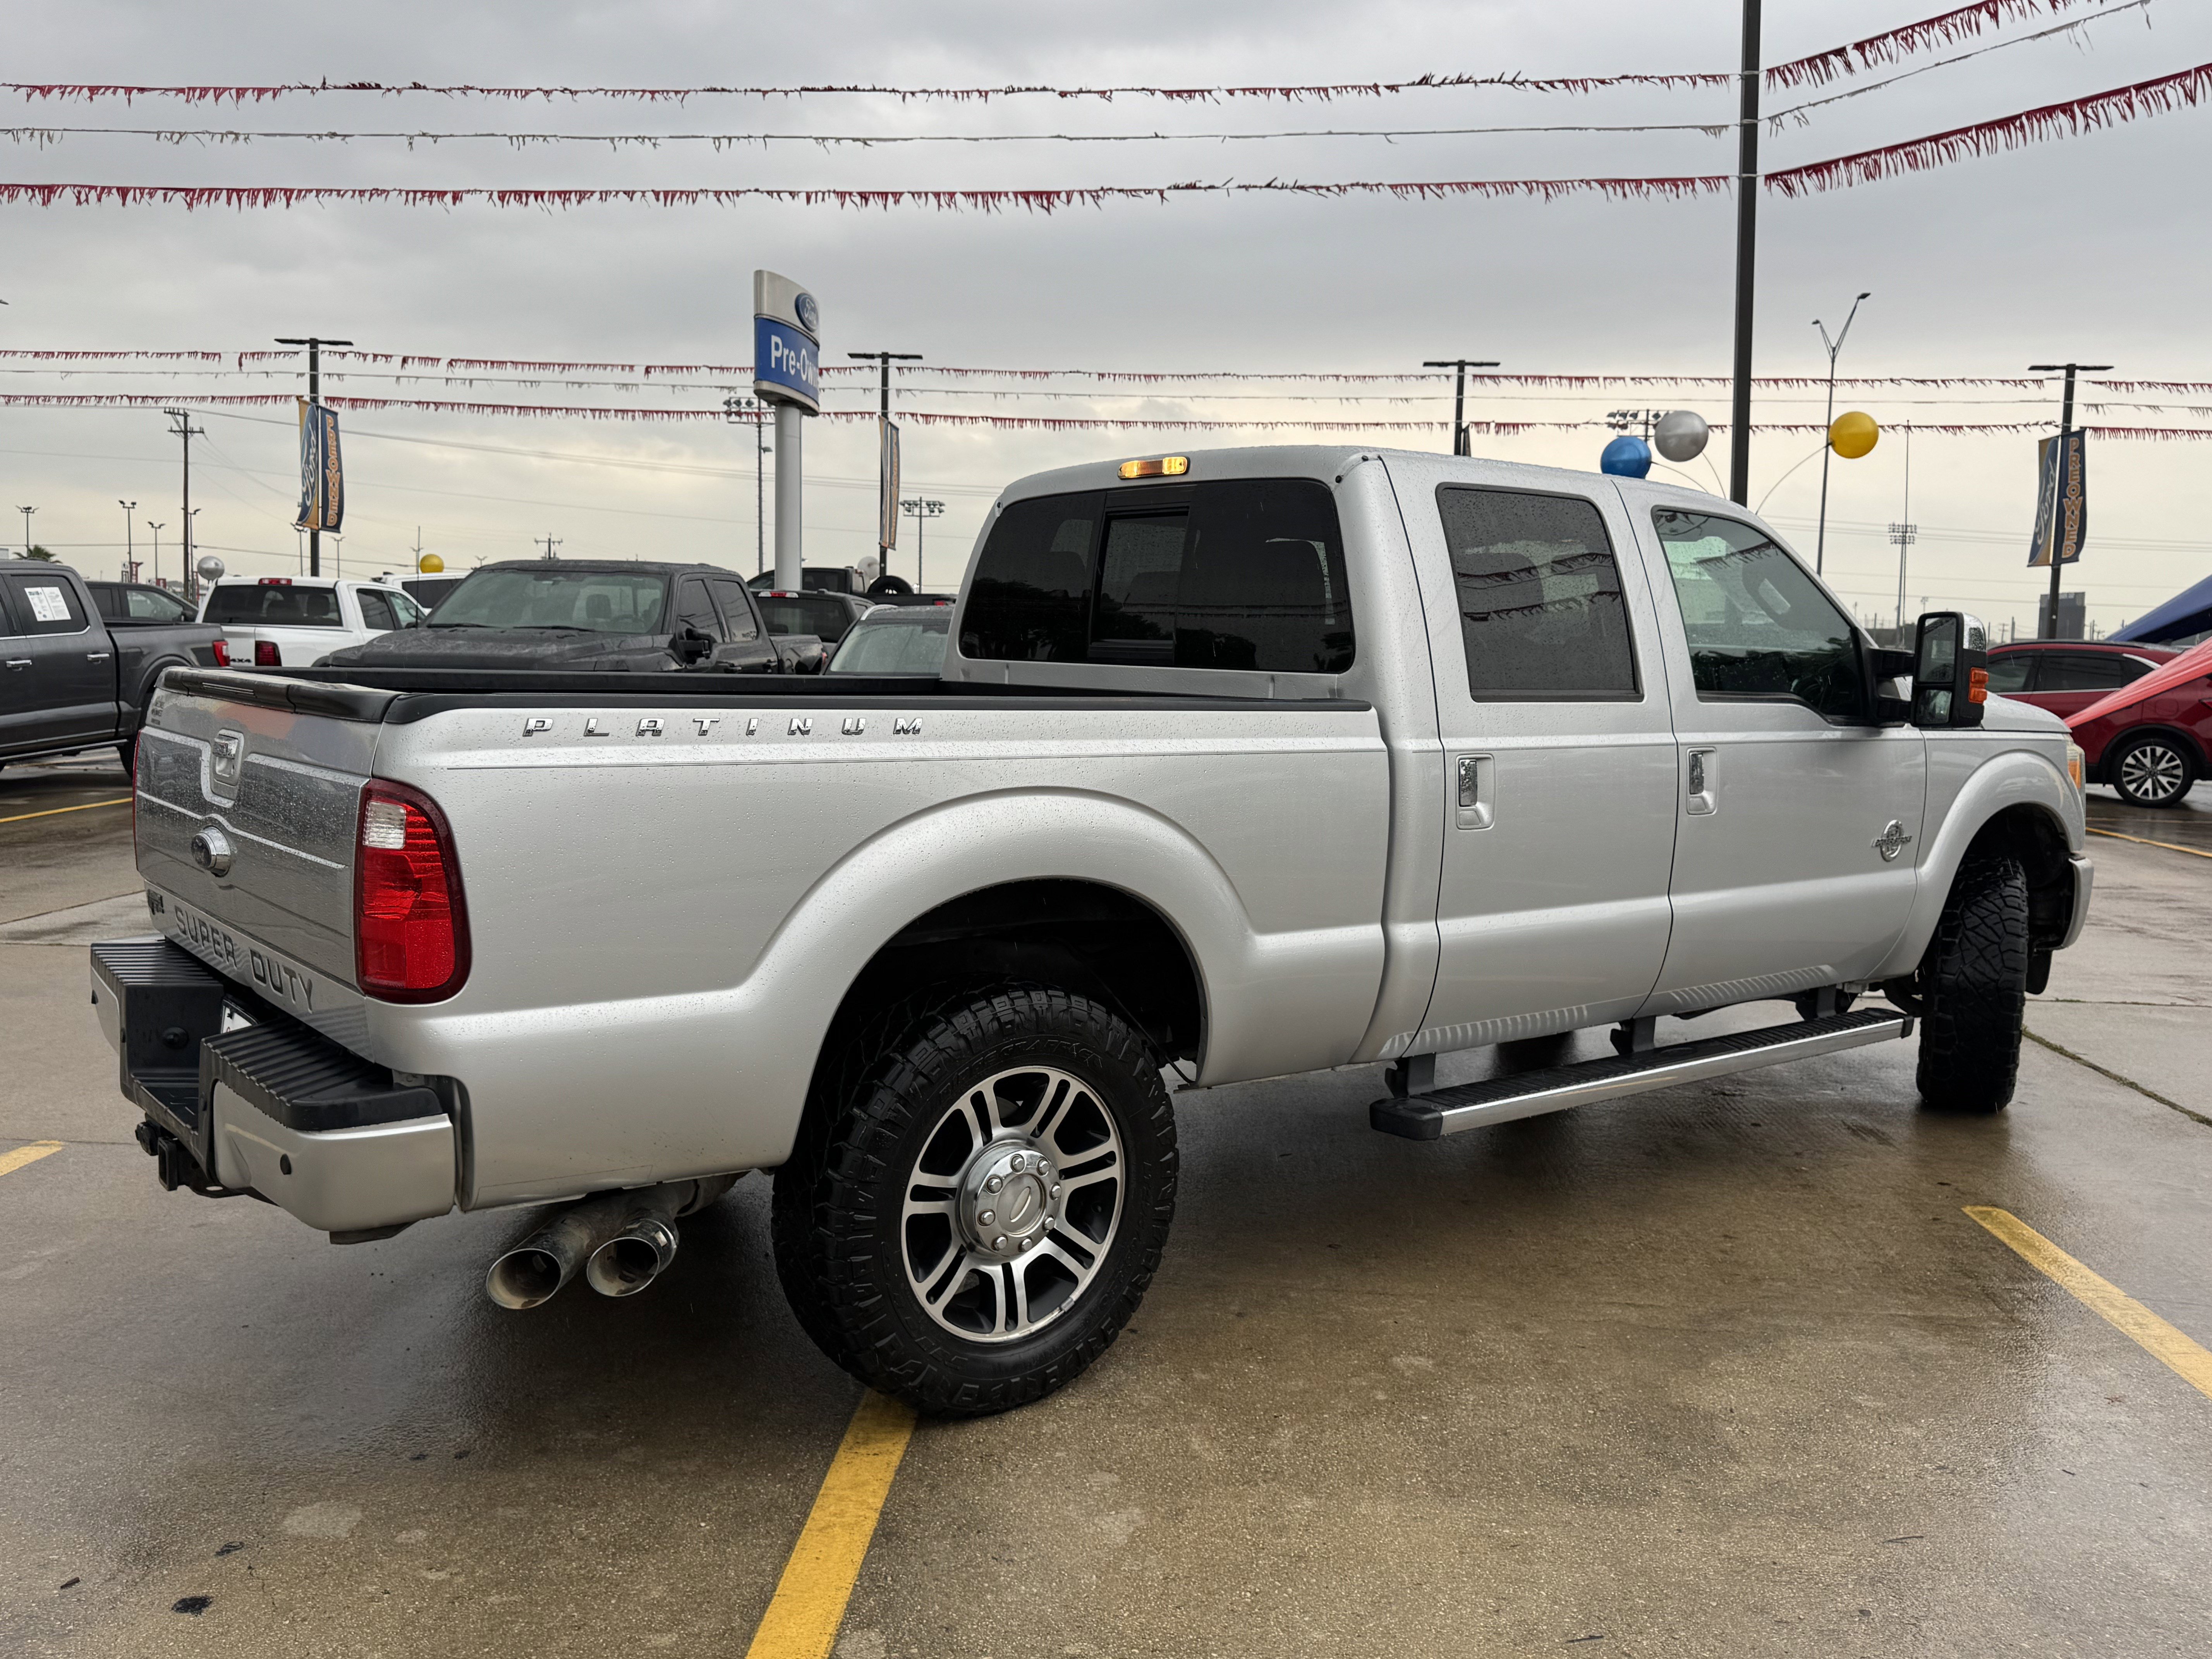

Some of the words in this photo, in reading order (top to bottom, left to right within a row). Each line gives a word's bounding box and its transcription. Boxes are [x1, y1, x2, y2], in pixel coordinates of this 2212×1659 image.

[2035, 457, 2056, 545] Ford
[2061, 437, 2083, 558] PREOWNED
[522, 717, 924, 737] PLATINUM
[174, 904, 237, 970] SUPER
[249, 946, 313, 1015] DUTY
